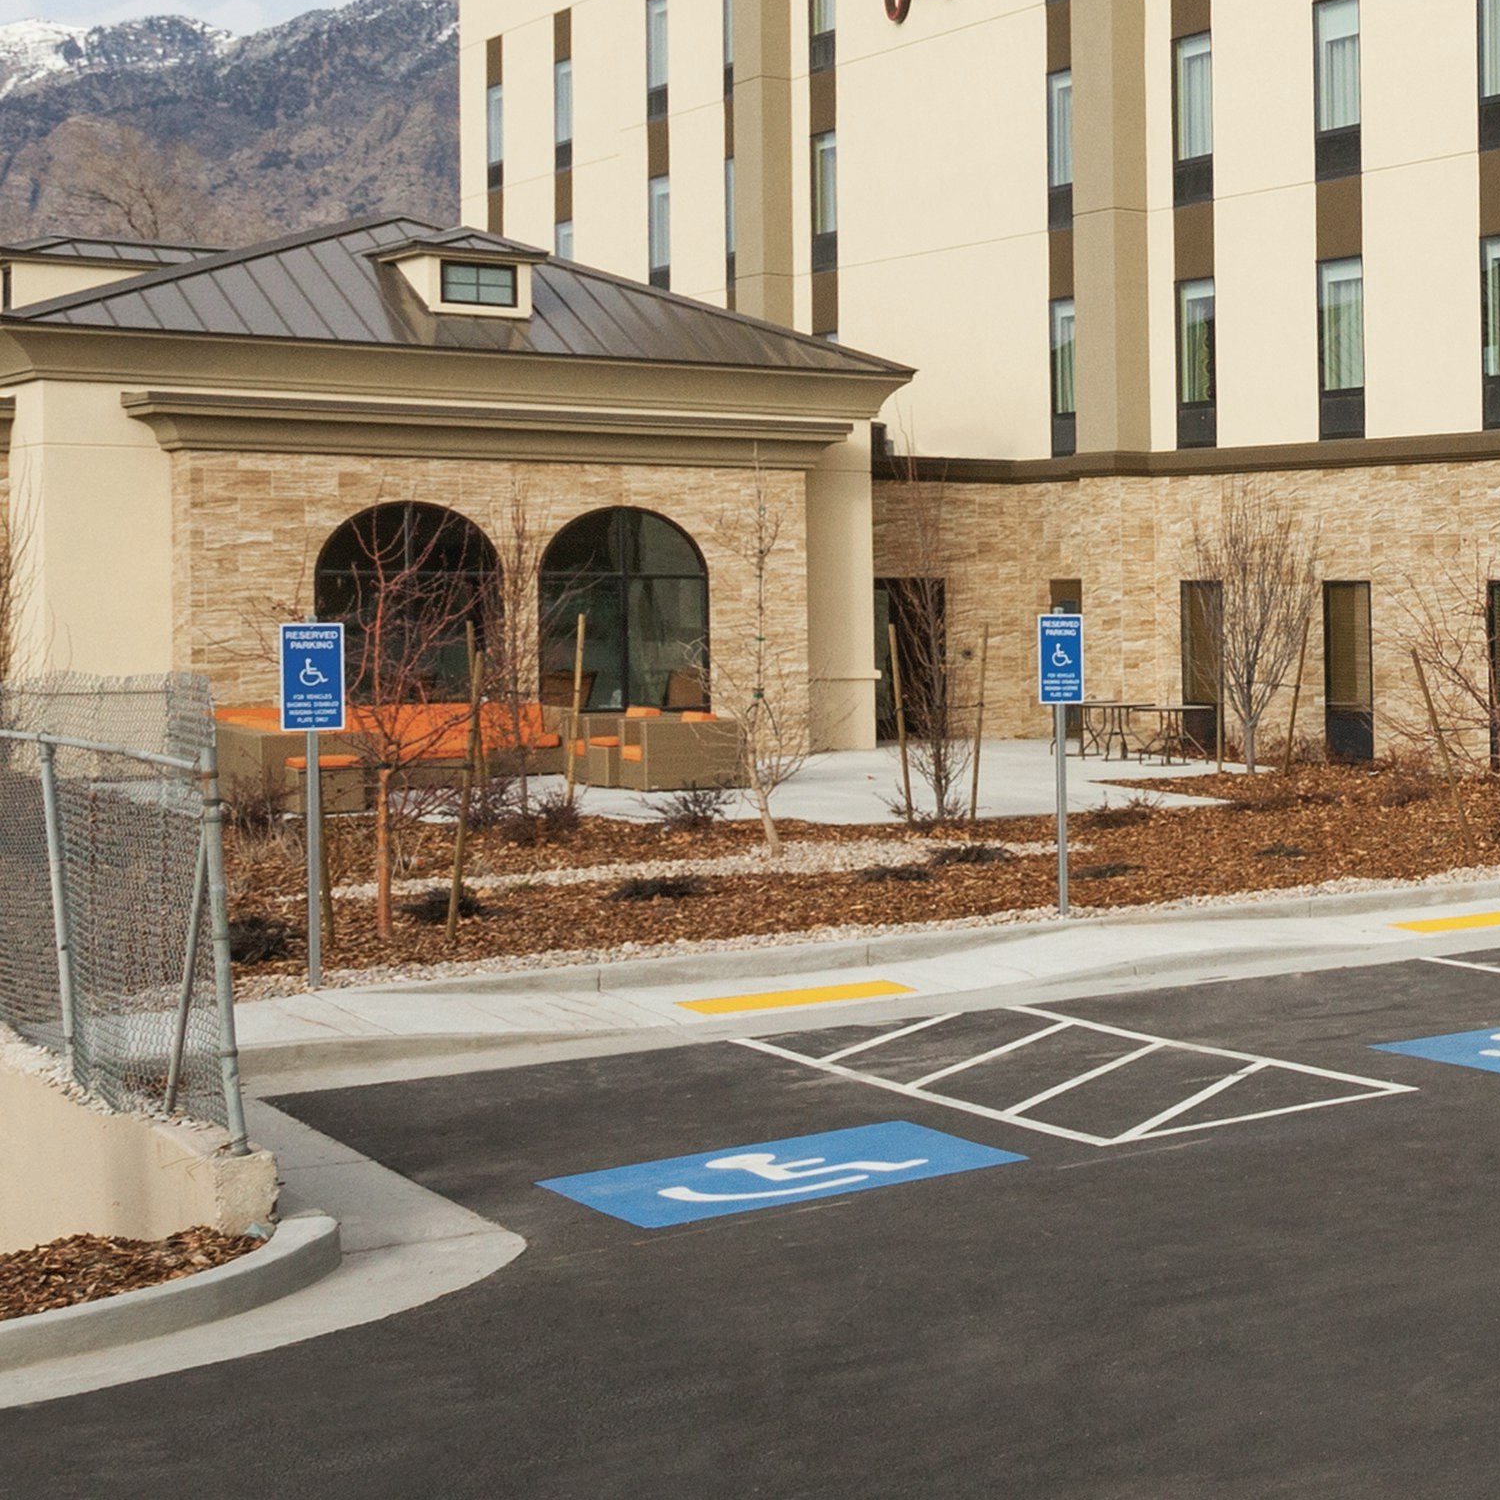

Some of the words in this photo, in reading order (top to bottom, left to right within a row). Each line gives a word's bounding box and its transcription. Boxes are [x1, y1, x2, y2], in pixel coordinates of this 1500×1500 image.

[1042, 620, 1080, 628] RESERVED
[285, 630, 339, 640] RESERVED
[289, 640, 334, 650] PARKING
